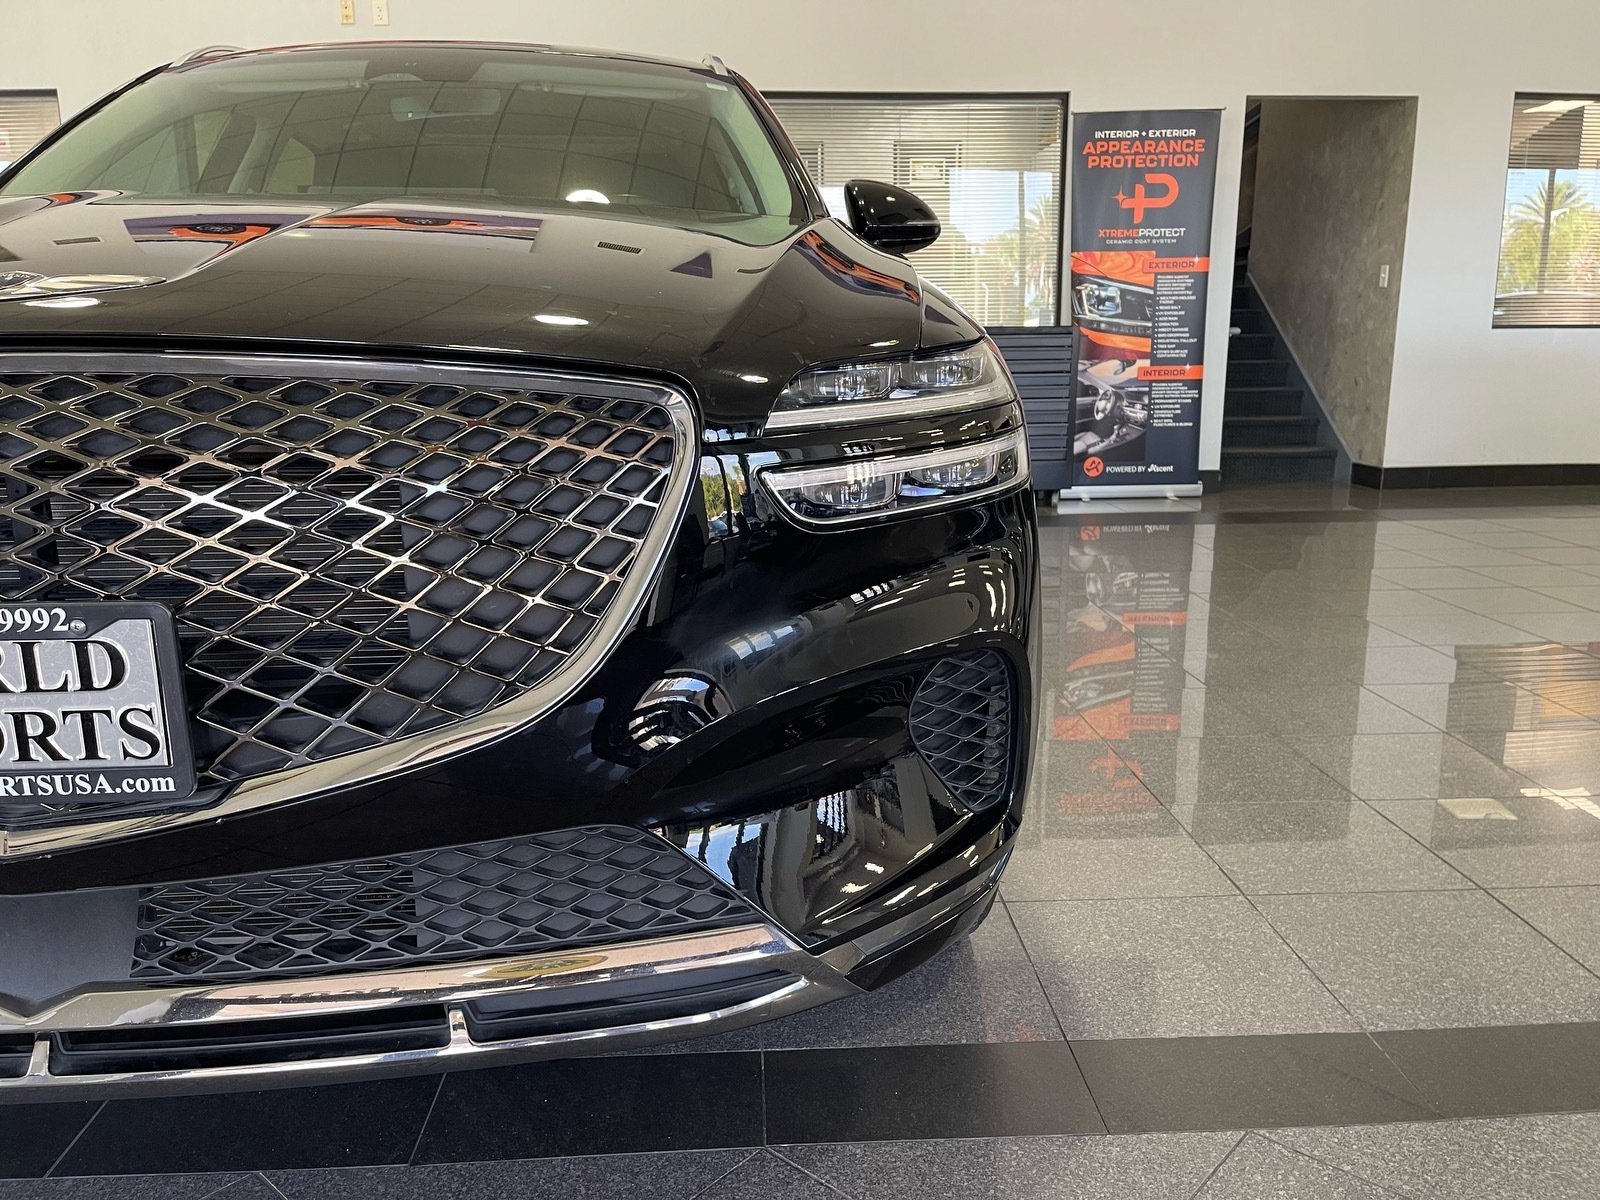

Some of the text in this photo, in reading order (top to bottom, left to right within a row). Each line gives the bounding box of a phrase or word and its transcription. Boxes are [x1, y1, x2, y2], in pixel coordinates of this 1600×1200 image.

[1095, 130, 1139, 138] INTERIOR
[1148, 129, 1196, 138] EXTERIOR
[1083, 139, 1206, 154] APPEARANCE
[1088, 154, 1199, 168] PROTECTION
[1098, 228, 1186, 237] XTREMEPROTECT
[1148, 261, 1195, 269] EXTERIOR
[1143, 369, 1186, 377] INTERIOR
[0, 707, 161, 762] RTS
[0, 773, 176, 797] RTSUSA.com
